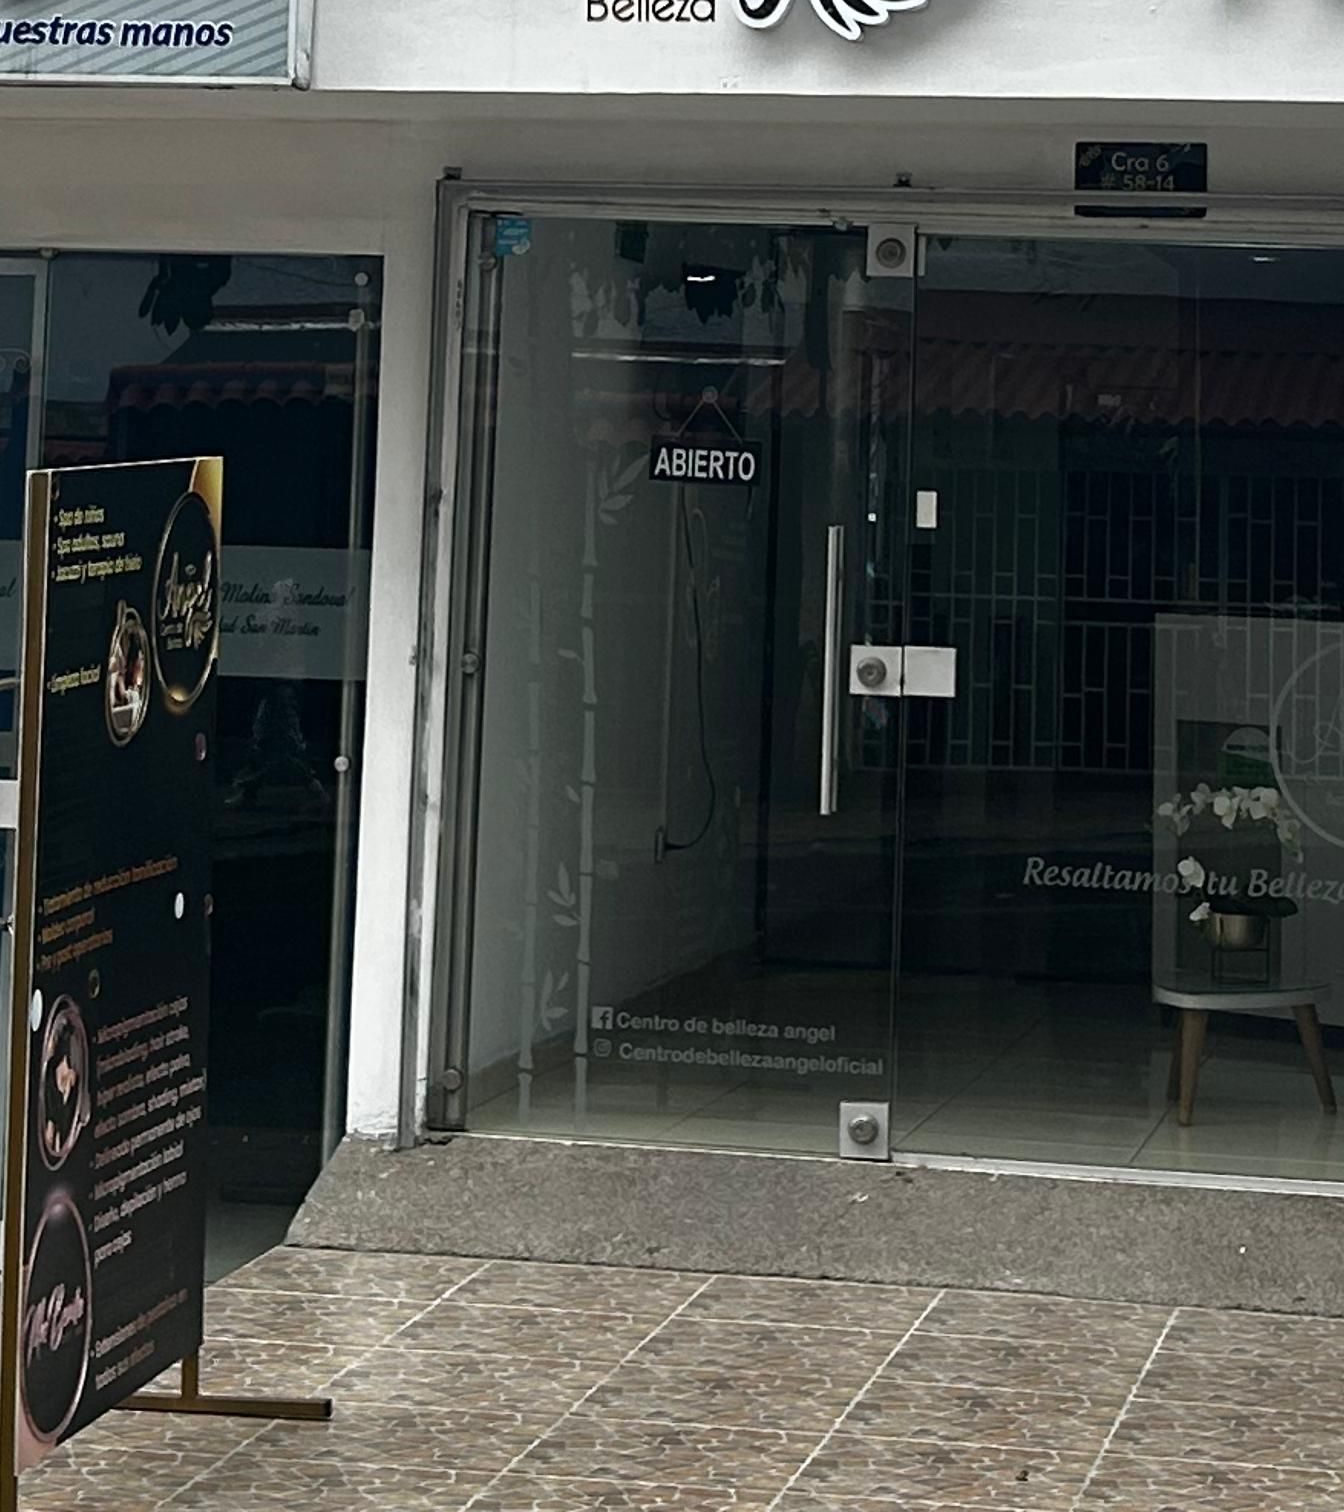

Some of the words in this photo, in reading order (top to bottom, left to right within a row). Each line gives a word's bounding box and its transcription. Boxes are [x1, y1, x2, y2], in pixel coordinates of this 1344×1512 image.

[121, 21, 233, 49] manos
[1111, 152, 1149, 171] Cra
[1156, 152, 1169, 172] 6
[1123, 174, 1175, 191] 58-14
[653, 444, 756, 482] ABIERTO
[1022, 856, 1191, 895] Resaltamos
[1205, 864, 1241, 899] tu
[616, 1010, 680, 1034] Centro
[684, 1014, 707, 1035] de
[711, 1016, 779, 1040] belleza
[782, 1019, 836, 1044] angel
[619, 1039, 885, 1076] Centrodebellezaangeloficial
